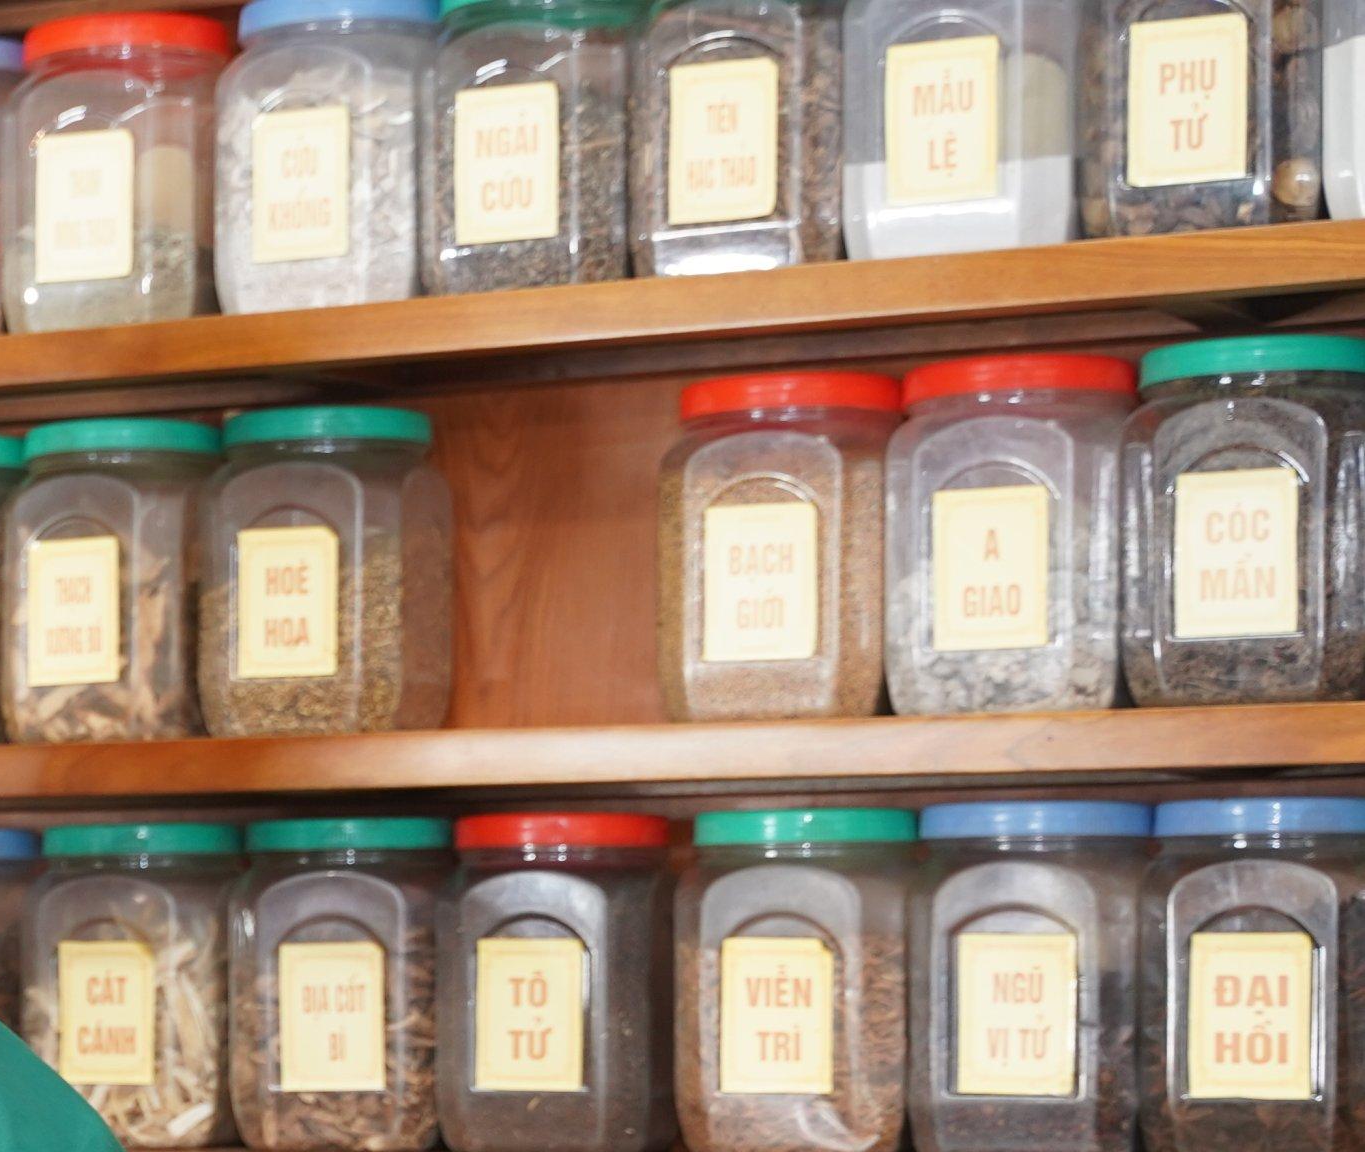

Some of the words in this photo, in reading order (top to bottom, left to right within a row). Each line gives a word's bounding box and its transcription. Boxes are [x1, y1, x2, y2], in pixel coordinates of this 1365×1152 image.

[1158, 58, 1218, 100] PHỤ
[1169, 102, 1209, 151] TỬ
[727, 542, 795, 584] BẠCH
[982, 528, 1001, 562] A
[962, 583, 1023, 619] GIAO
[508, 970, 549, 1009] TÔ
[1213, 974, 1290, 1015] ĐẠI
[76, 1019, 137, 1056] CÁNH
[507, 1016, 553, 1062] TỬ
